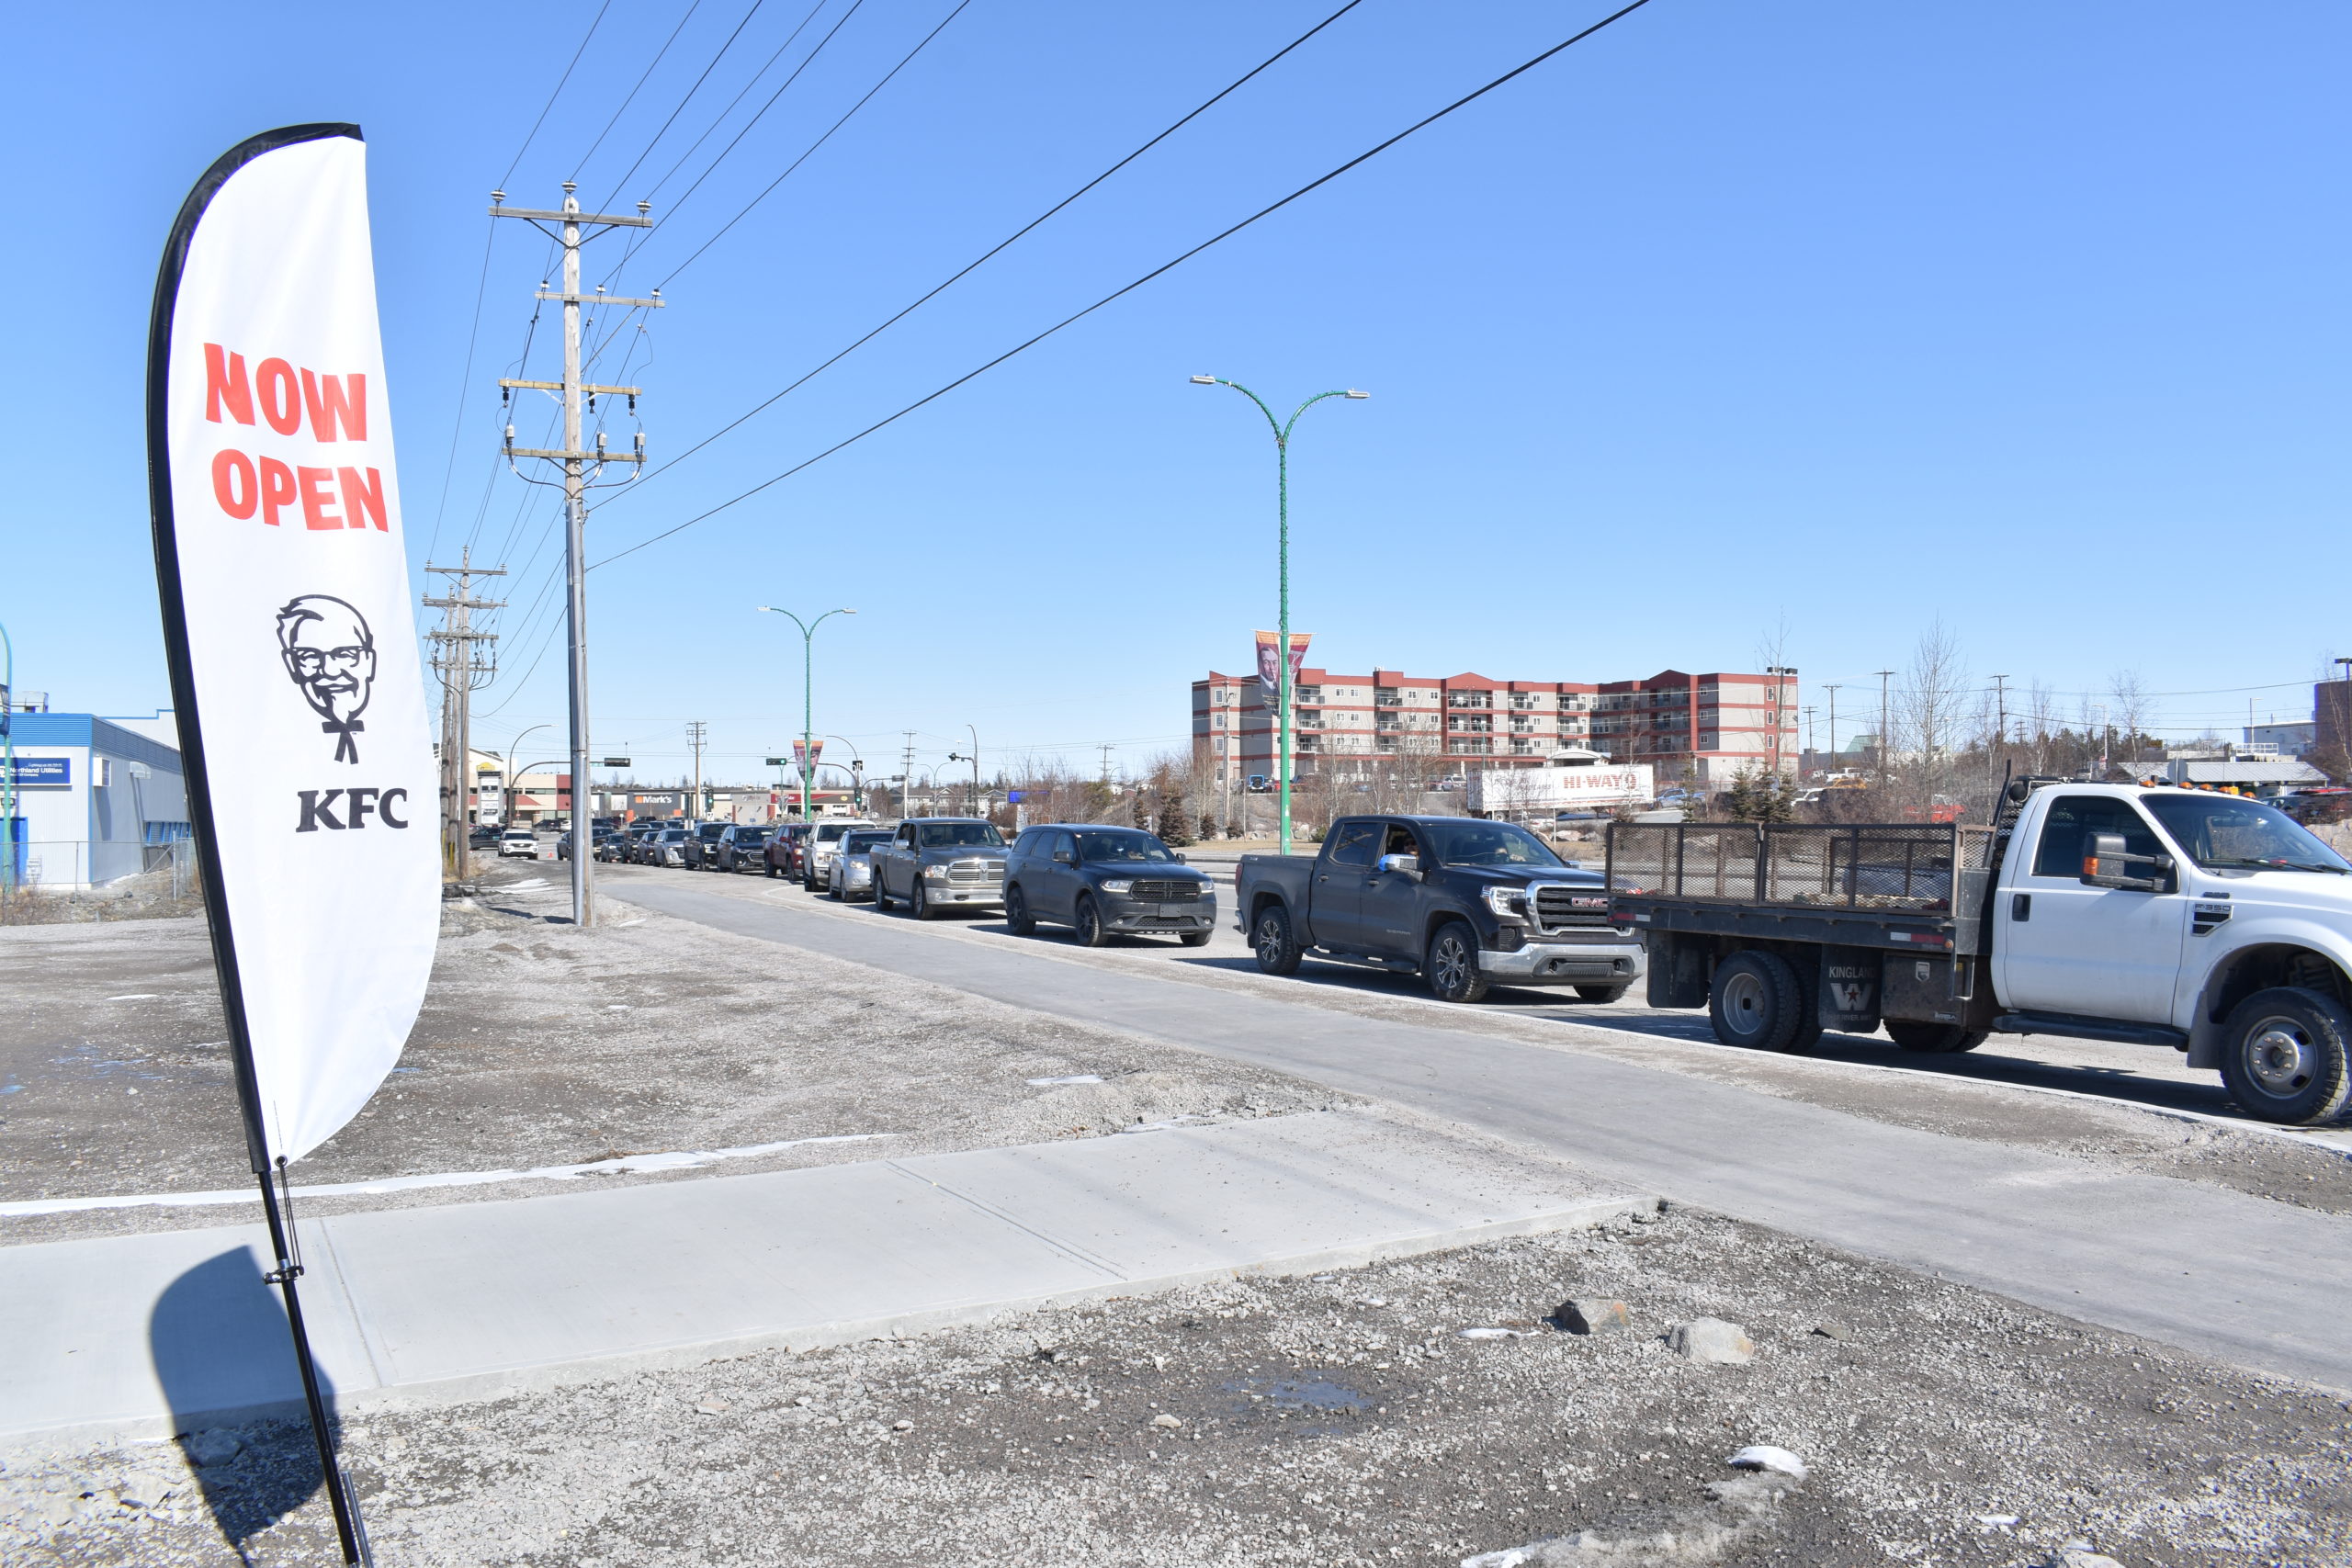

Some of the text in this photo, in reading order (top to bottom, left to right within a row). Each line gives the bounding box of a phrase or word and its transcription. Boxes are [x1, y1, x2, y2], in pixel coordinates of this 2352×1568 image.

[204, 343, 368, 443] NOW
[211, 448, 390, 533] OPEN
[1563, 774, 1623, 788] HI-WAY
[643, 795, 673, 804] Mark's
[296, 787, 409, 833] KFC
[1572, 897, 1608, 908] GMC
[2195, 903, 2231, 912] F-350
[1828, 966, 1876, 978] KINGLAND
